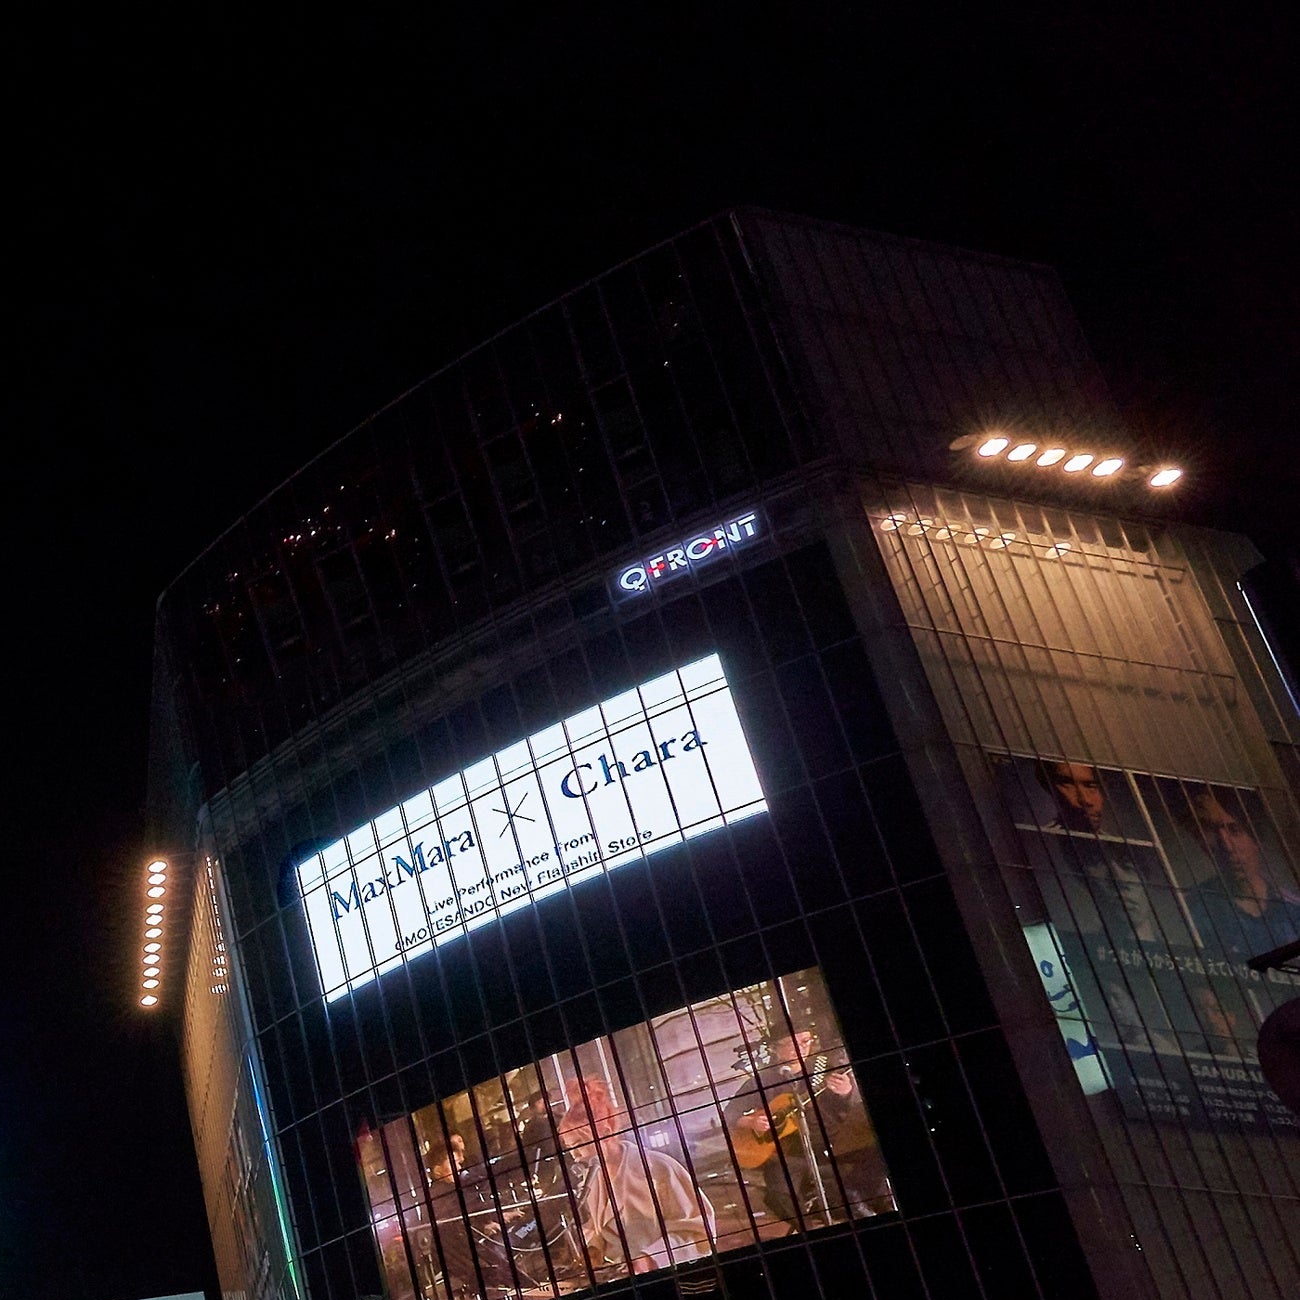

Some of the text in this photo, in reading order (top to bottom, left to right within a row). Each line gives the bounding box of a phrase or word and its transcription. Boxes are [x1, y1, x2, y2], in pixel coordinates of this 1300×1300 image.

[621, 513, 756, 592] QFRONT
[331, 827, 476, 922] MaxMara
[560, 728, 708, 801] Chara
